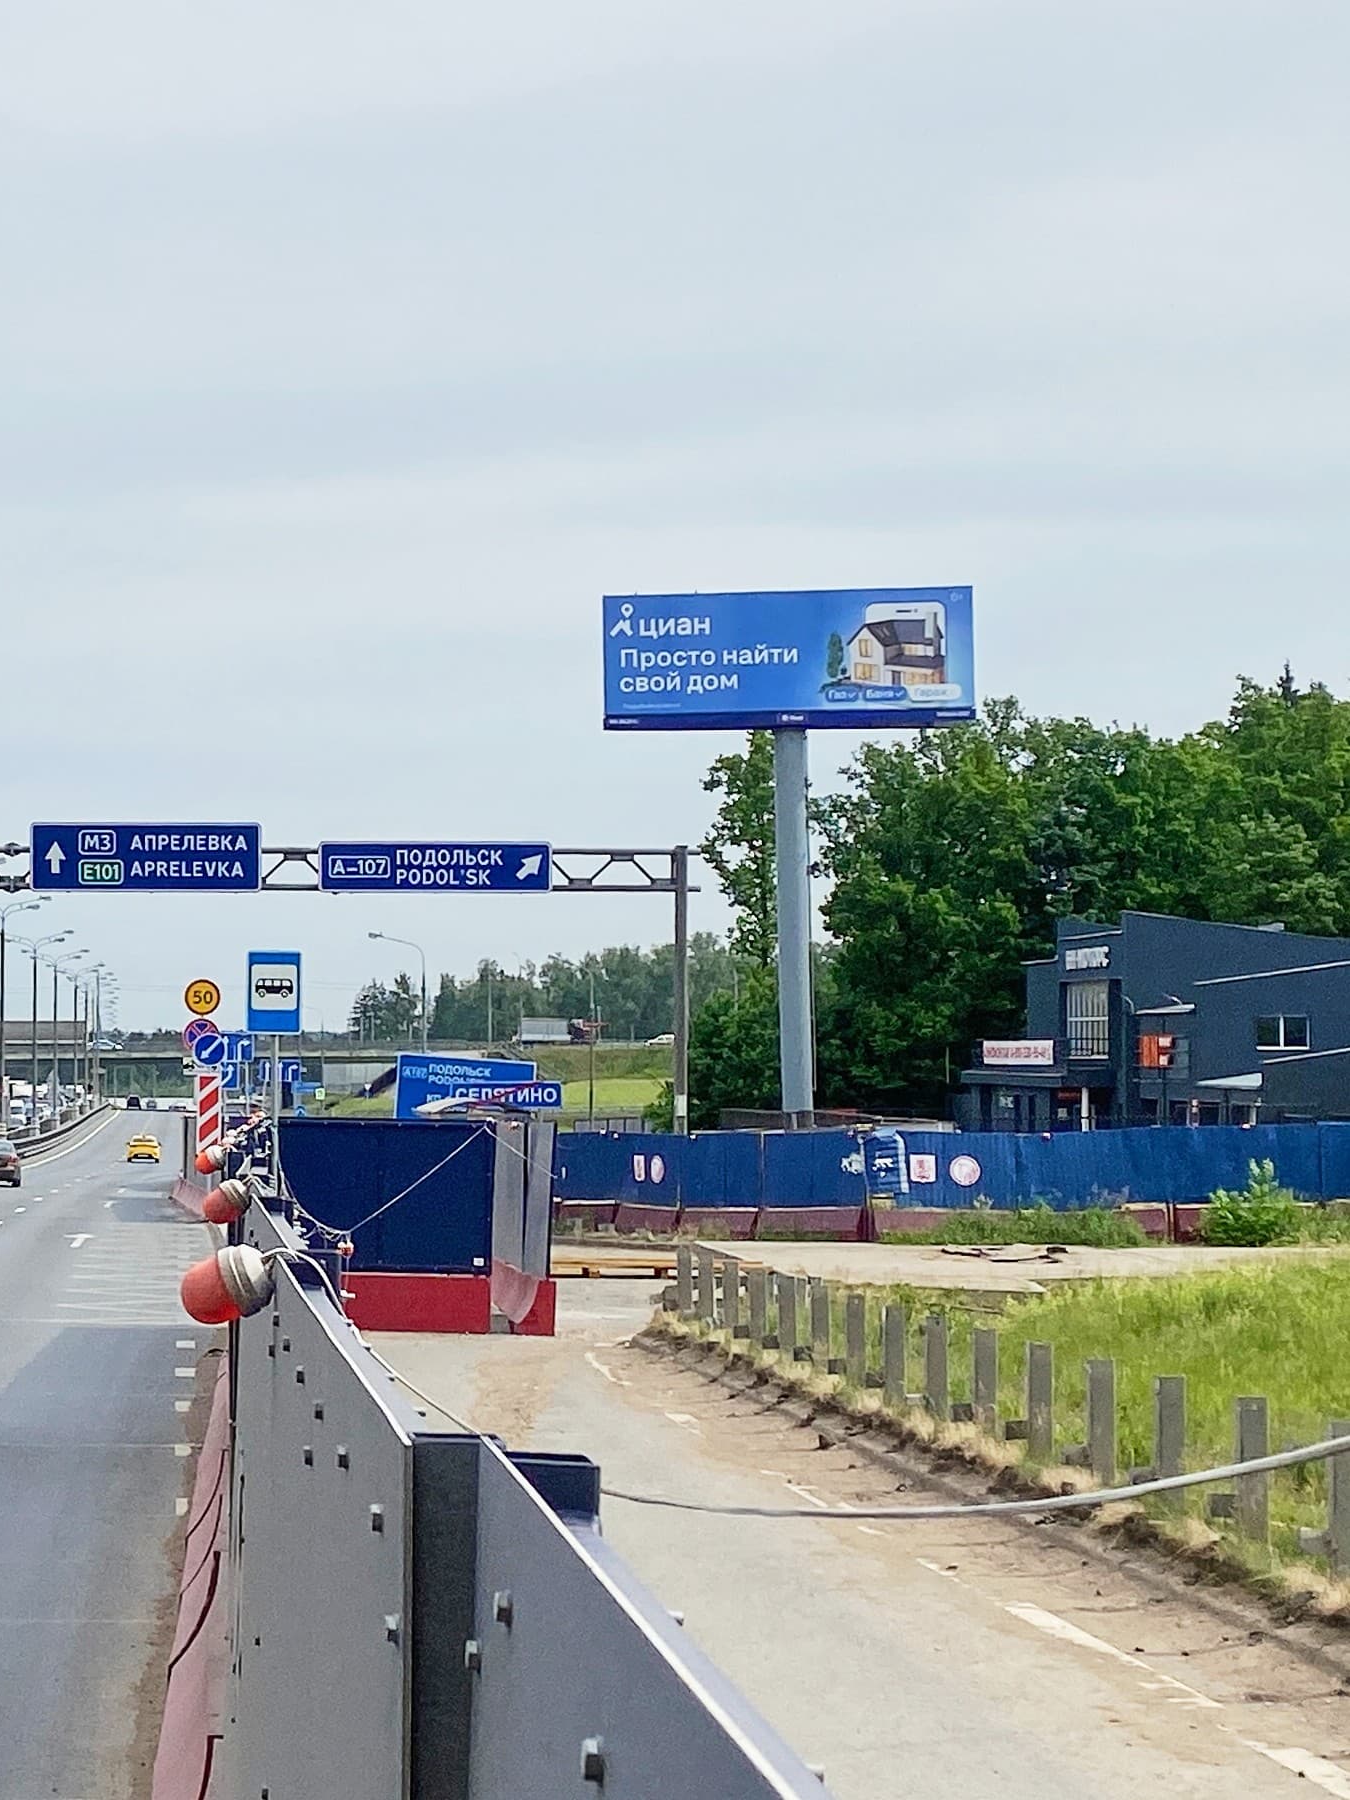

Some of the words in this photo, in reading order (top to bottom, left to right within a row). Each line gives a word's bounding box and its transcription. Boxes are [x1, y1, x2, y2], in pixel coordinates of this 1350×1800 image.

[639, 616, 711, 639] циан
[620, 648, 716, 672] Просто
[722, 643, 798, 665] найти
[619, 670, 681, 693] свой
[686, 673, 739, 694] дом
[130, 834, 248, 851] АПРЕЛЕВКА
[395, 849, 504, 868] ПОДОЛЬСК
[83, 863, 120, 881] E101
[130, 861, 245, 878] APRELEVKA
[395, 869, 491, 885] PODOL'SK
[192, 990, 214, 1005] 50
[428, 1063, 492, 1077] ПОДОЛЬСК
